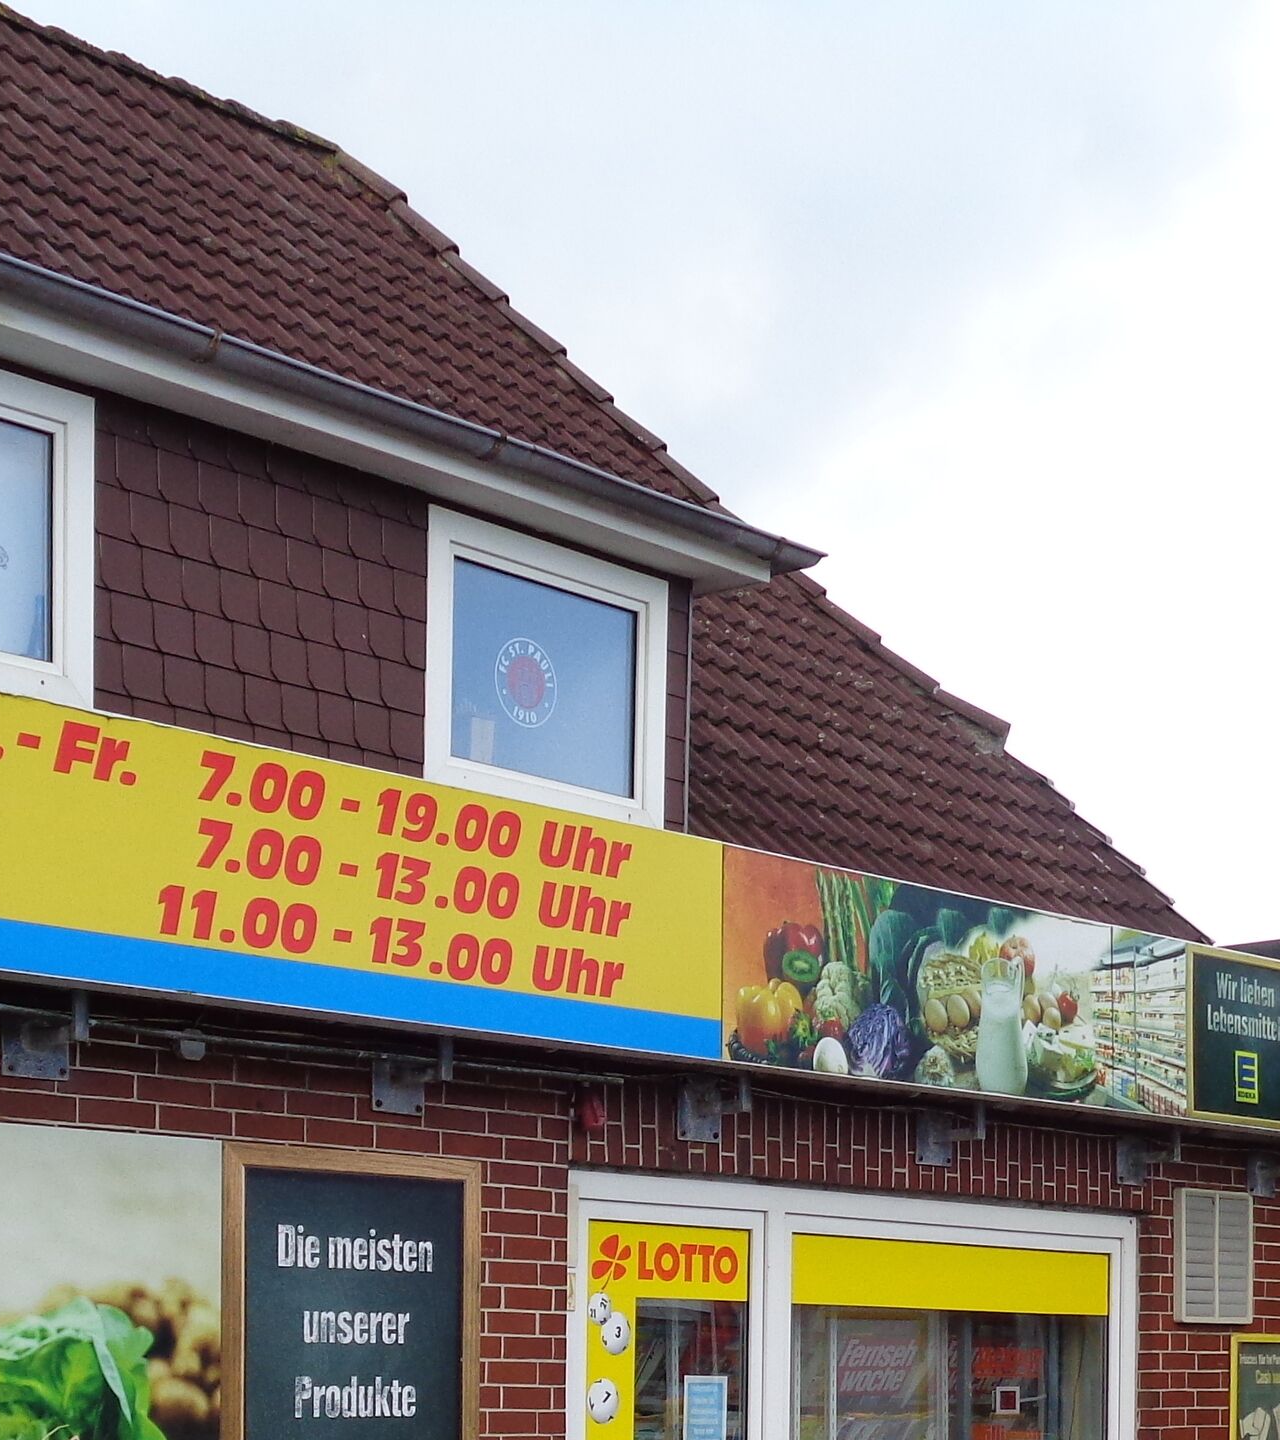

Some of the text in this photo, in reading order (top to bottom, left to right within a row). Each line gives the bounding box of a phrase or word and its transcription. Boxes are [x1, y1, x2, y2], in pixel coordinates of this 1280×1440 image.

[498, 655, 510, 673] FC
[527, 644, 554, 688] PAULI
[513, 706, 538, 724] 1910
[53, 720, 138, 787] Fr.
[198, 749, 327, 821] 7.00
[376, 787, 522, 859] 19.00
[538, 820, 633, 880] Uhr
[196, 817, 322, 886] 7.00
[375, 851, 520, 920] 13.00
[537, 880, 633, 938] Uhr
[157, 883, 318, 955] 11.00
[368, 915, 514, 986] 13.00
[531, 944, 626, 999] Uhr
[1215, 971, 1276, 1009] Wir lieben
[276, 1223, 434, 1275] Die meisten
[637, 1241, 739, 1284] LOTTO
[302, 1305, 411, 1347] unserer
[614, 1326, 622, 1338] 3
[293, 1374, 417, 1420] Produkte
